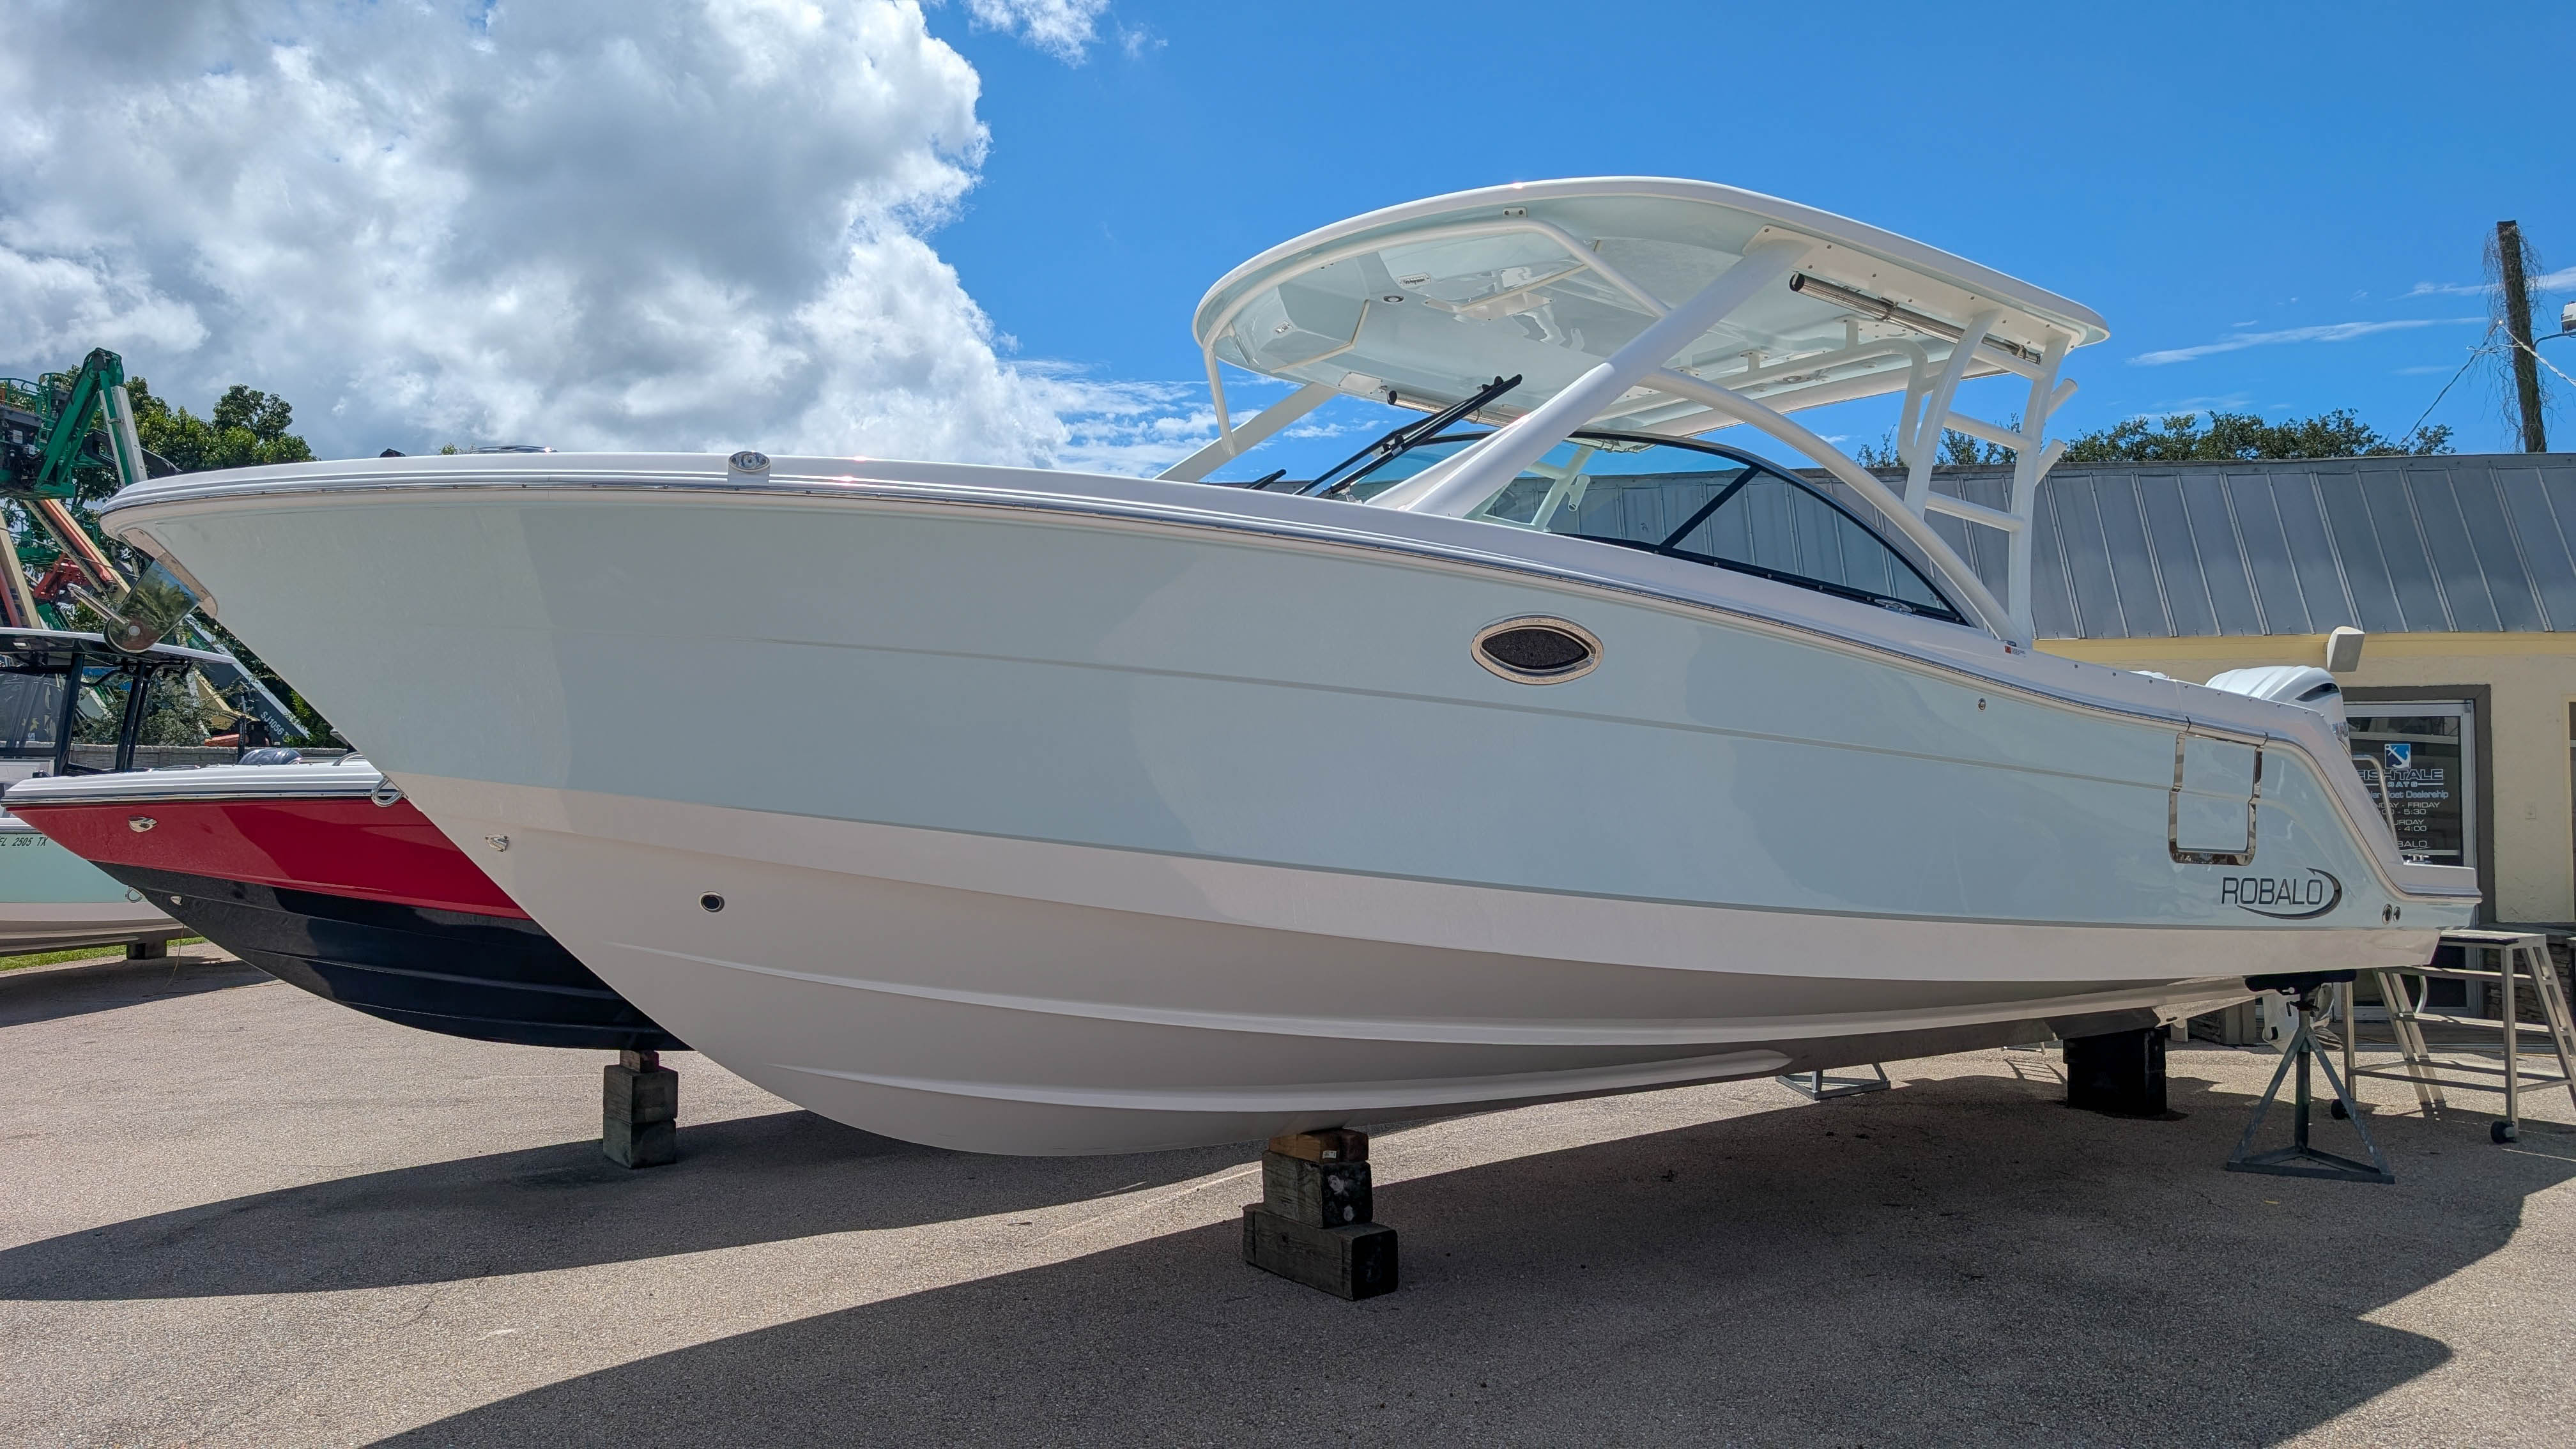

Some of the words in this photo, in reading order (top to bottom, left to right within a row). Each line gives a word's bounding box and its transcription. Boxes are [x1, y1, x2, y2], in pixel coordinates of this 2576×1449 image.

[261, 711, 284, 735] SJ1056
[2406, 790, 2448, 800] Dealership
[12, 837, 34, 847] 2505
[36, 837, 49, 847] TX
[2221, 877, 2323, 905] ROBALO
